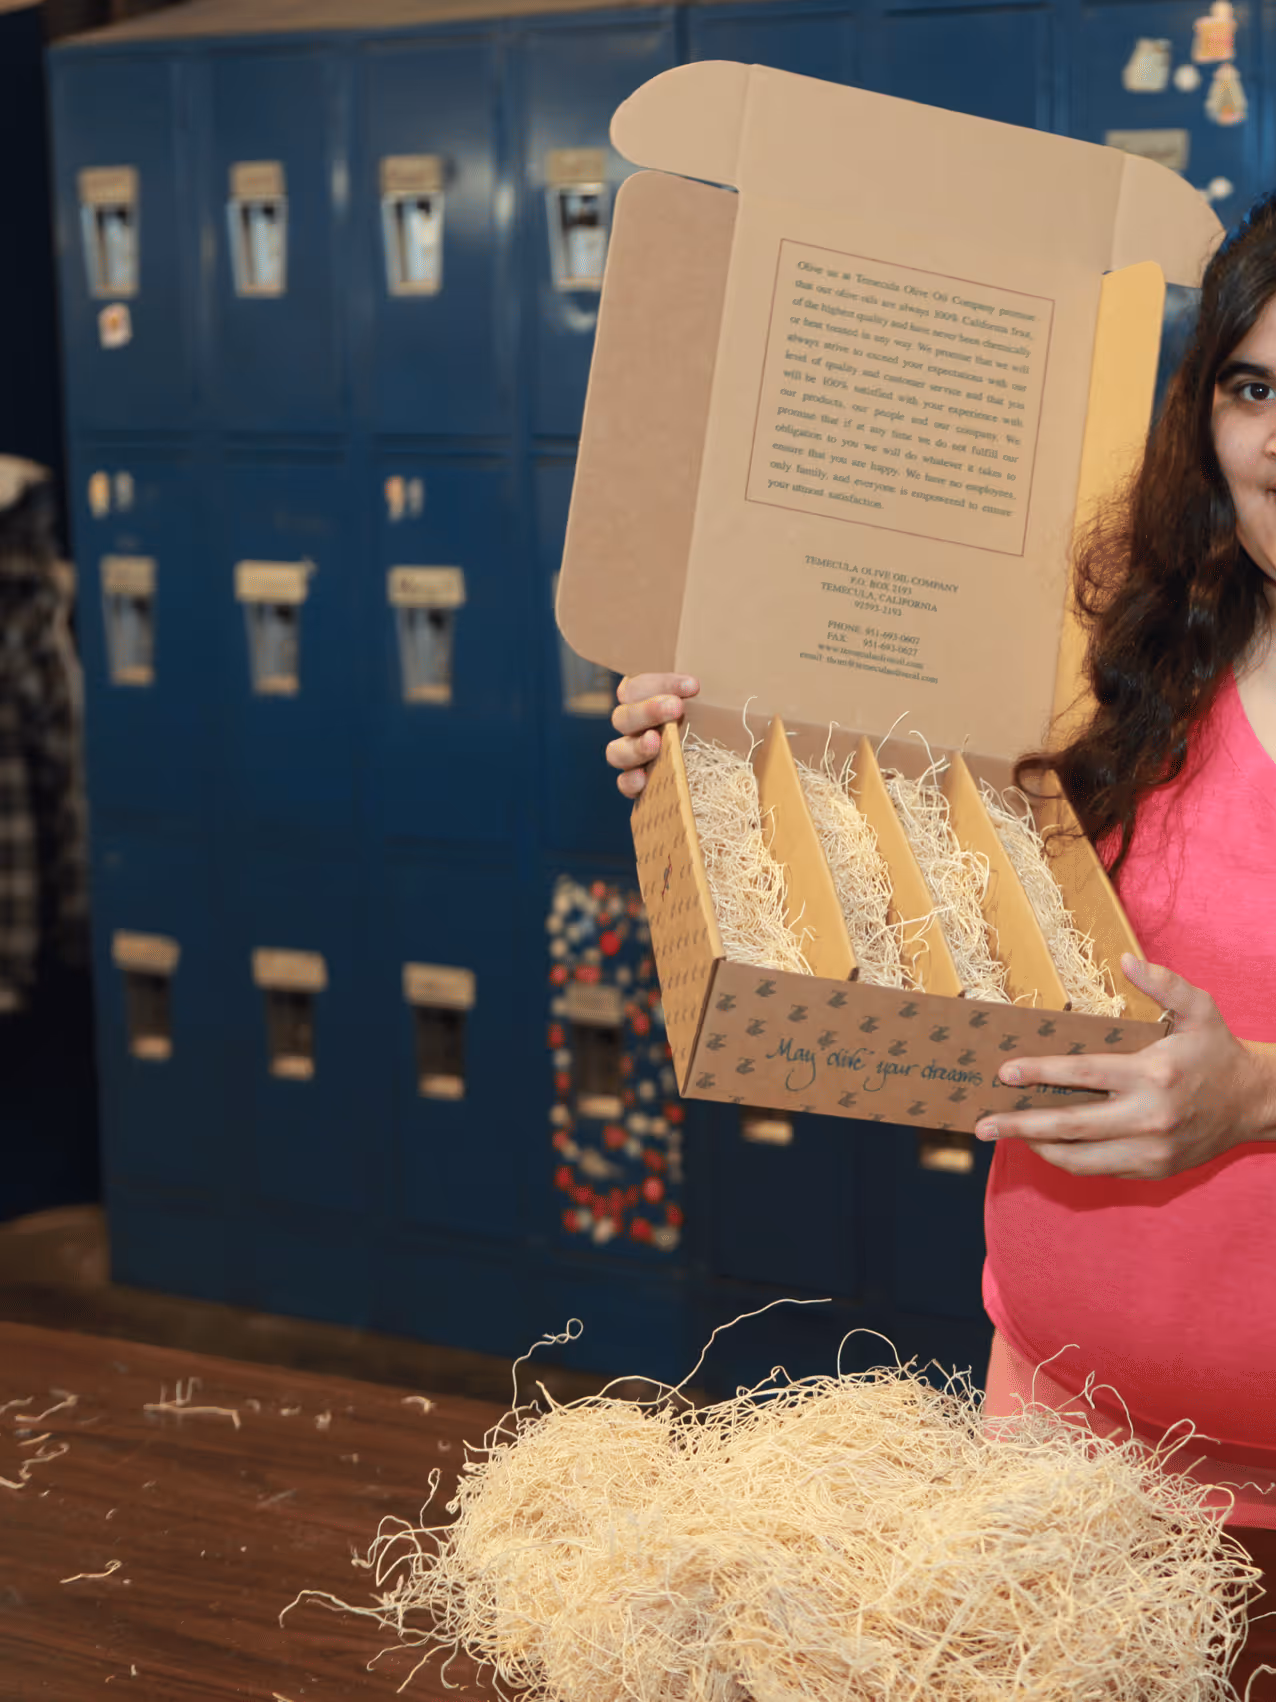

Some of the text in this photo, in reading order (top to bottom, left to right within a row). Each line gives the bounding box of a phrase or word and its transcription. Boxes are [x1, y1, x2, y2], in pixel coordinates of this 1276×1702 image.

[766, 1038, 816, 1092] May
[863, 1060, 920, 1092] your
[921, 1059, 983, 1086] dreams
